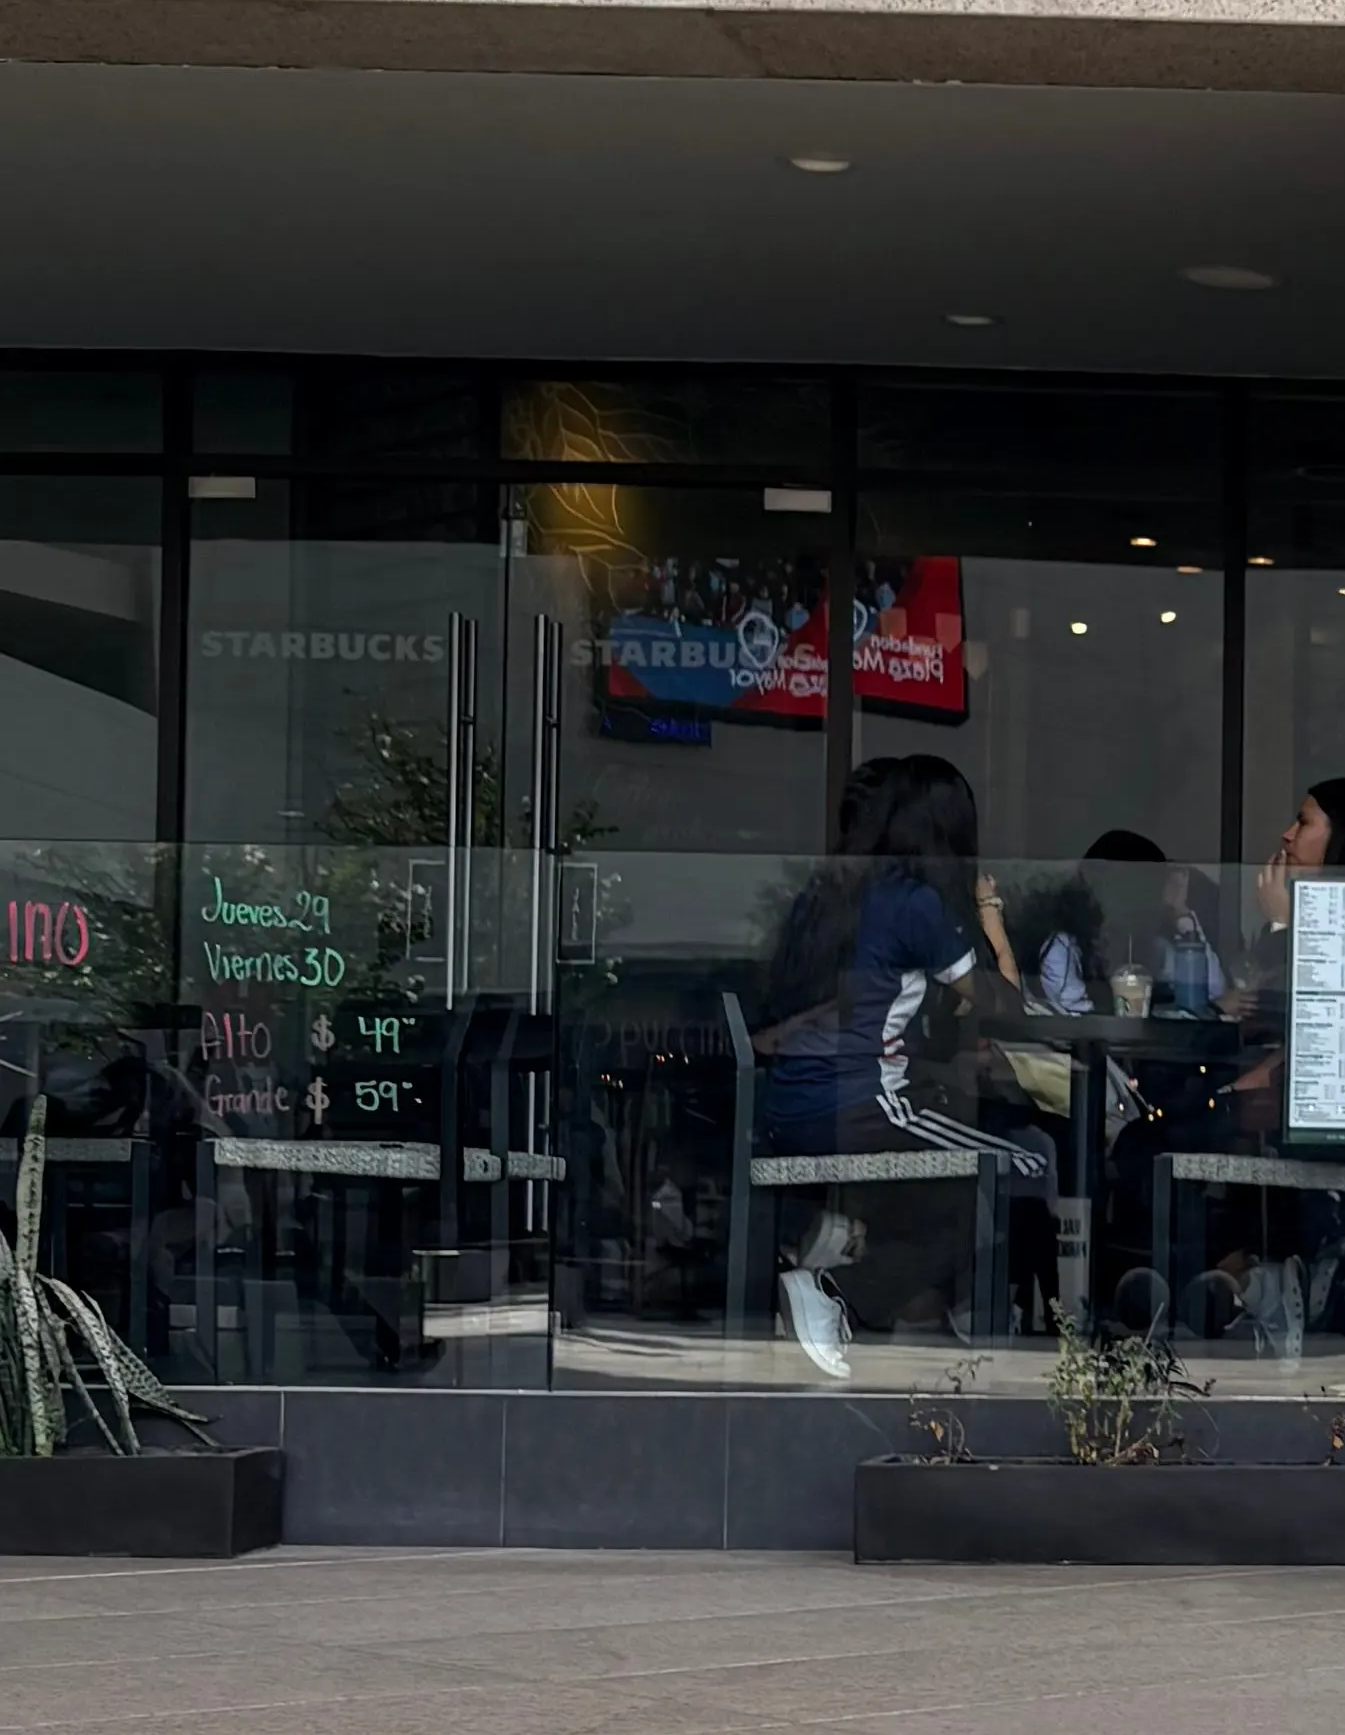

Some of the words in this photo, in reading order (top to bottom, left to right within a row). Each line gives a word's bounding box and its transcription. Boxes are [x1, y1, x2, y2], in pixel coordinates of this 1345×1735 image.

[201, 631, 445, 663] STARBUCKS
[200, 876, 288, 929] Jueves
[288, 889, 331, 935] 29
[203, 940, 300, 982] Viernes
[300, 946, 346, 987] 30
[201, 1010, 271, 1062] Alto
[311, 1013, 336, 1052] $
[204, 1073, 291, 1118] Grande
[305, 1076, 331, 1125] $
